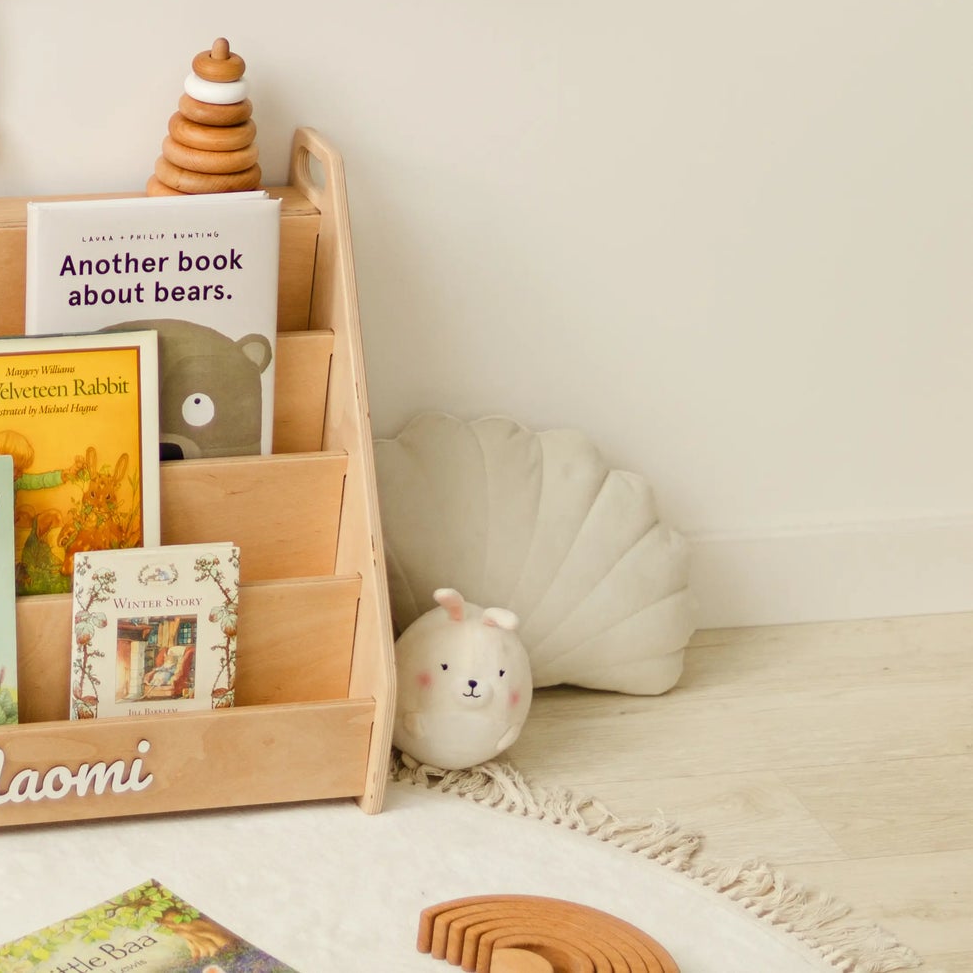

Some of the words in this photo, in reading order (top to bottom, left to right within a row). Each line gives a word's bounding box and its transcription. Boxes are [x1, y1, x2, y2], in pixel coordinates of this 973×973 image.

[82, 235, 114, 243] LAURA
[173, 230, 219, 239] BUNTING
[59, 252, 169, 277] Another
[178, 248, 244, 273] book
[68, 281, 145, 307] about
[154, 281, 233, 304] bears.
[6, 367, 39, 379] Margery
[41, 364, 76, 375] Williams
[73, 376, 130, 396] Rabbit
[28, 405, 38, 418] by
[39, 404, 69, 416] Michael
[70, 403, 99, 416] Hague
[113, 597, 162, 609] WINTER
[166, 595, 203, 607] STORY
[99, 935, 158, 960] Baa
